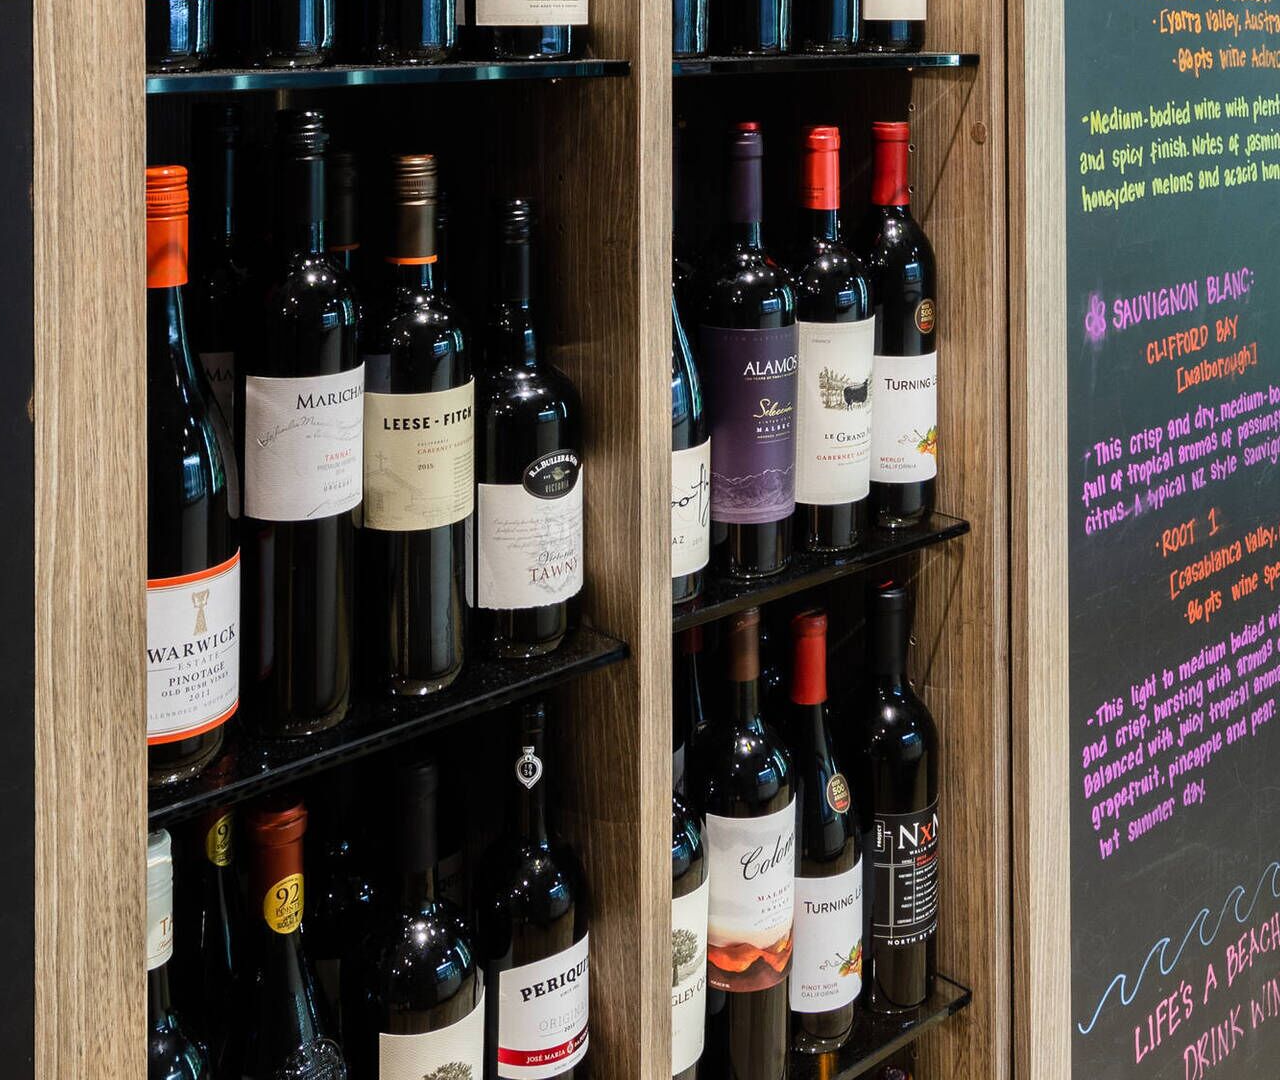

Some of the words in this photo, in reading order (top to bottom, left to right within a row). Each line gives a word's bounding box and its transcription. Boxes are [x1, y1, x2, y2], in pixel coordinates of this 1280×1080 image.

[1113, 283, 1199, 330] SAUVIGNON
[1206, 267, 1255, 304] BLANC:
[1146, 324, 1209, 365] CLIFFORD
[1216, 314, 1240, 342] BAY
[743, 355, 799, 376] ALAMOS
[884, 378, 931, 391] TURNING
[383, 417, 431, 431] LEESE
[756, 423, 791, 433] MALBEC
[1208, 506, 1221, 537] 1
[146, 624, 236, 664] WARWICK
[168, 661, 225, 687] PINOTAGE
[161, 689, 181, 698] OLD
[185, 681, 207, 693] BUSH
[275, 882, 300, 905] 92
[804, 895, 854, 915] TURNING
[888, 936, 916, 946] NORTH
[1133, 979, 1194, 1064] LIFE'S
[1203, 961, 1218, 1005] A
[1183, 1006, 1245, 1080] DRINK
